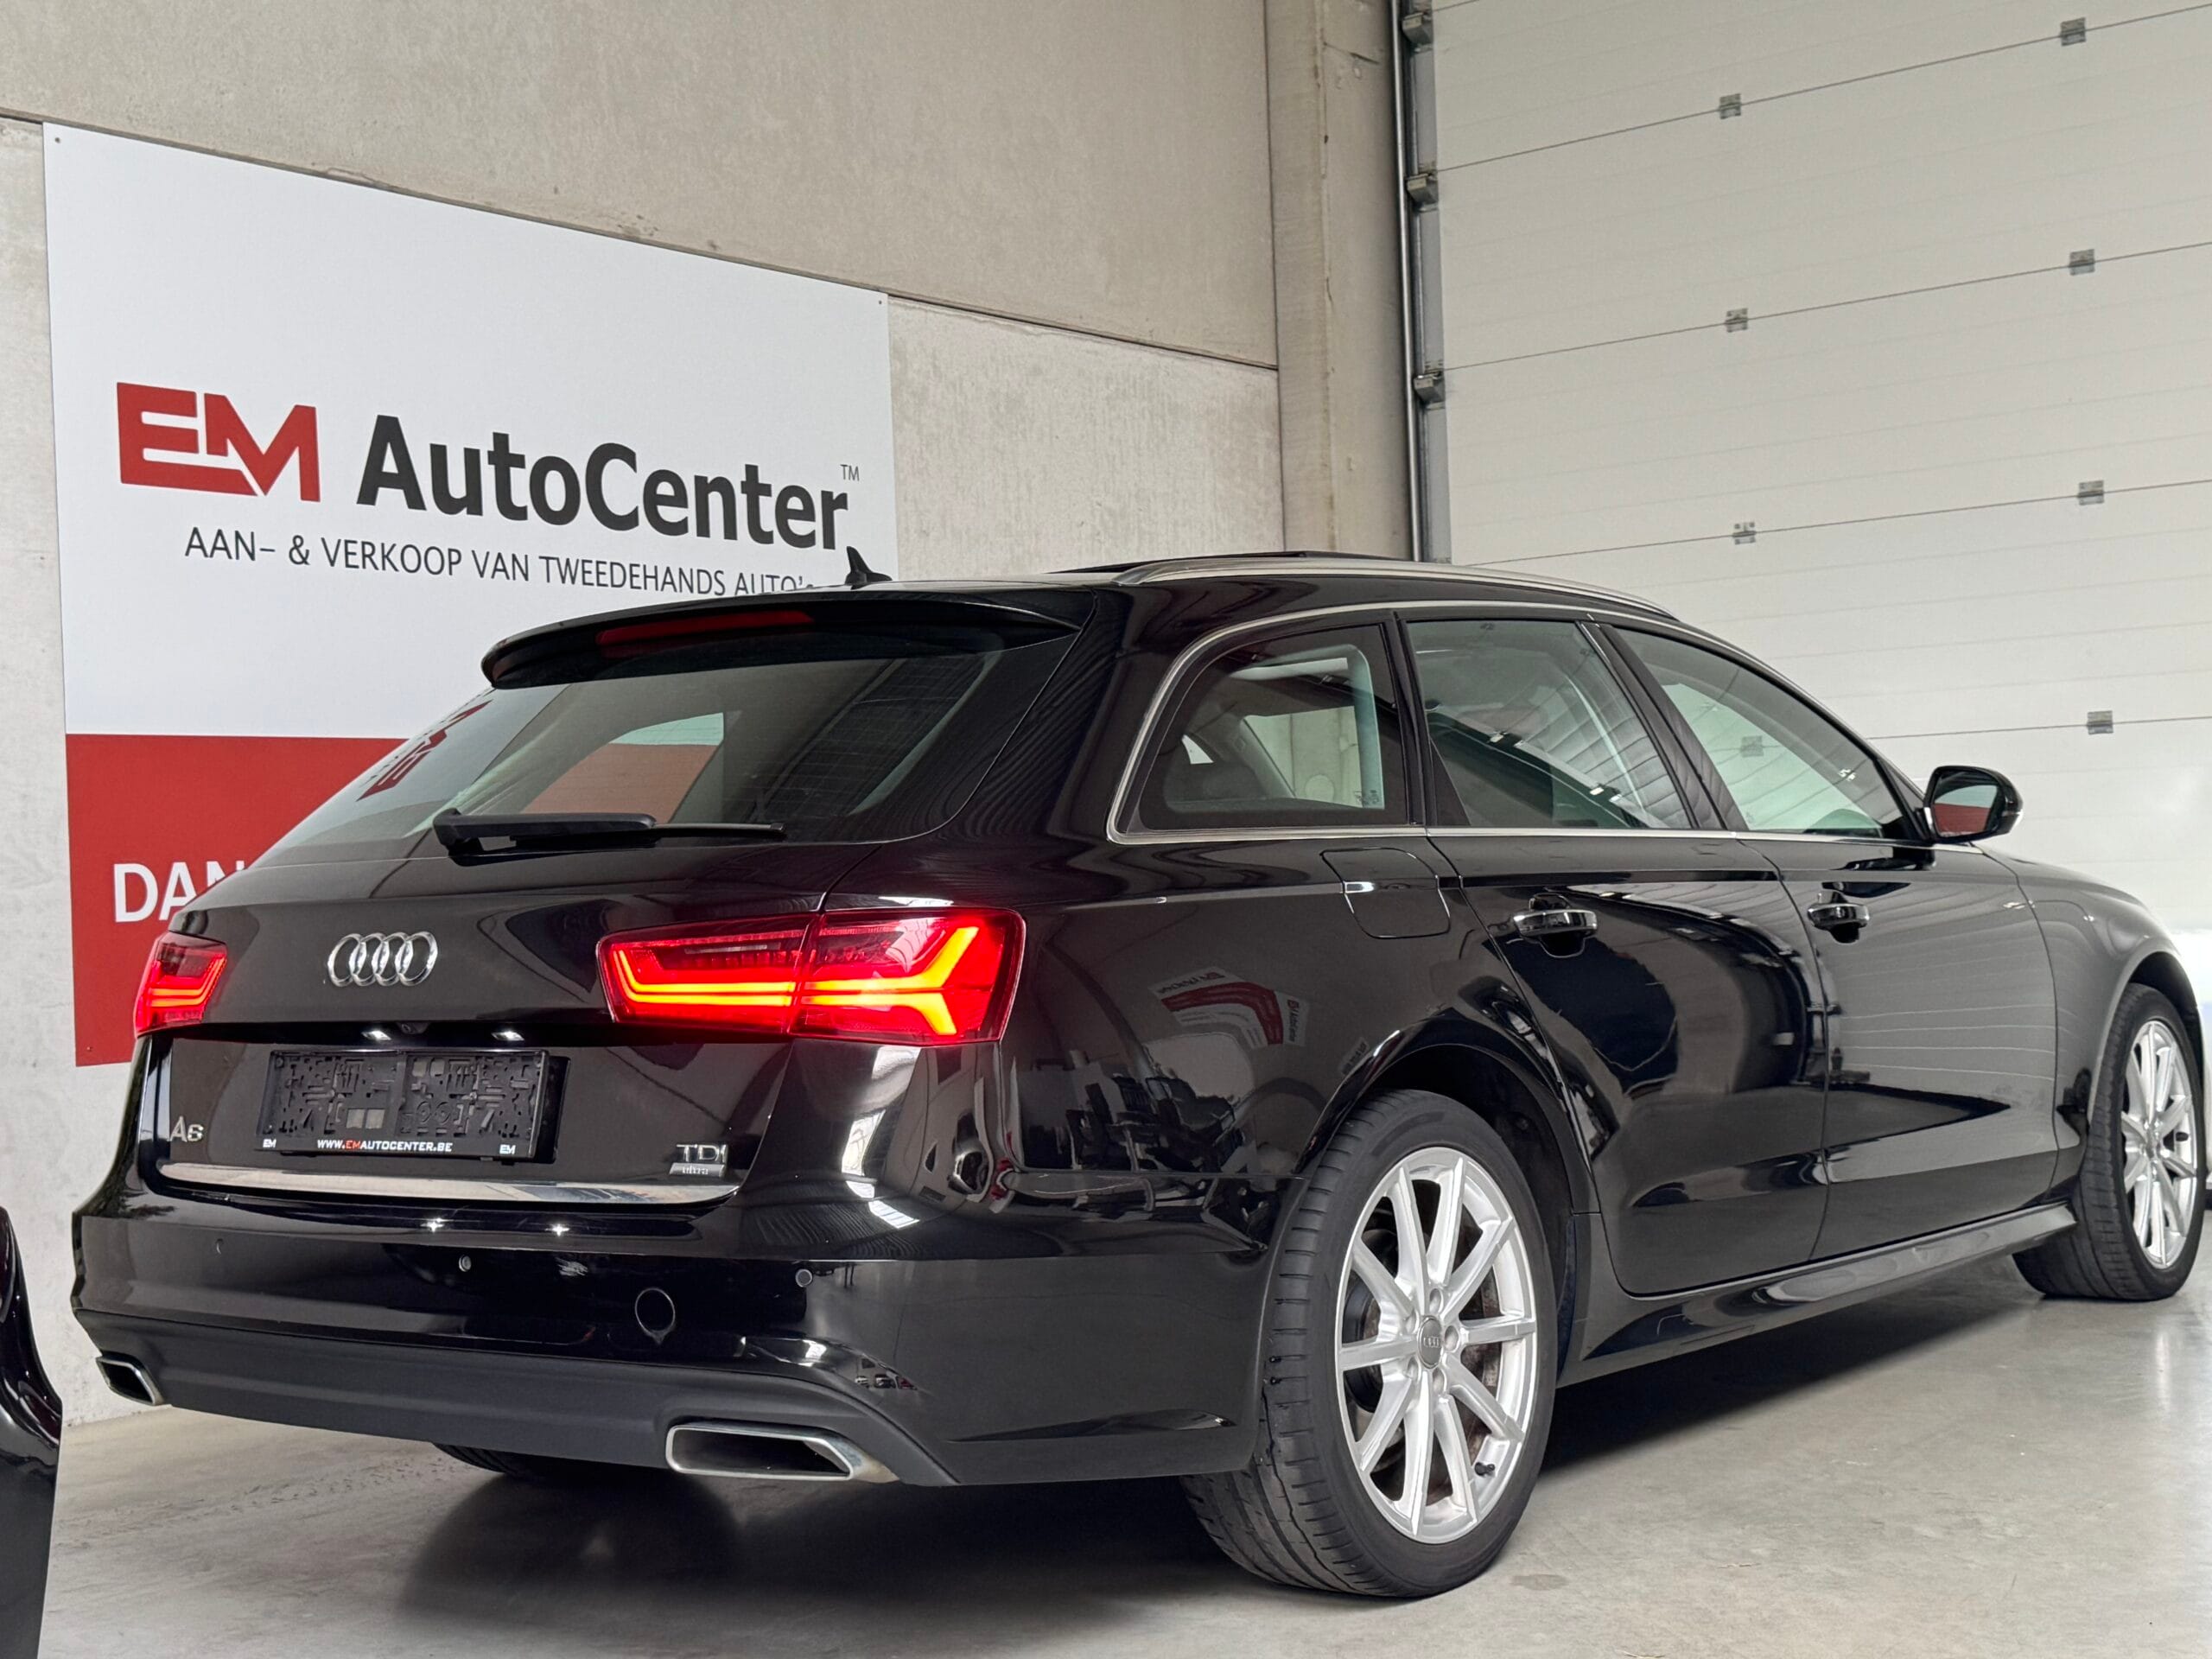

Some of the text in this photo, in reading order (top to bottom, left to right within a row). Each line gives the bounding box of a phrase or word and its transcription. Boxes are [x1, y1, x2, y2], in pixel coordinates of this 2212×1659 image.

[117, 382, 321, 502] EM
[357, 415, 849, 550] AutoCenter
[184, 526, 276, 562] AAN-
[289, 535, 310, 566] &
[321, 537, 462, 576] VERKOOP
[472, 550, 530, 582] VAN
[538, 556, 726, 596] TWEEDEHANDS
[168, 1116, 204, 1142] A6
[262, 1138, 277, 1148] EM
[316, 1139, 454, 1153] WWW.EMAUTOCENTER.BE
[499, 1144, 516, 1154] EM
[676, 1144, 727, 1163] TDI
